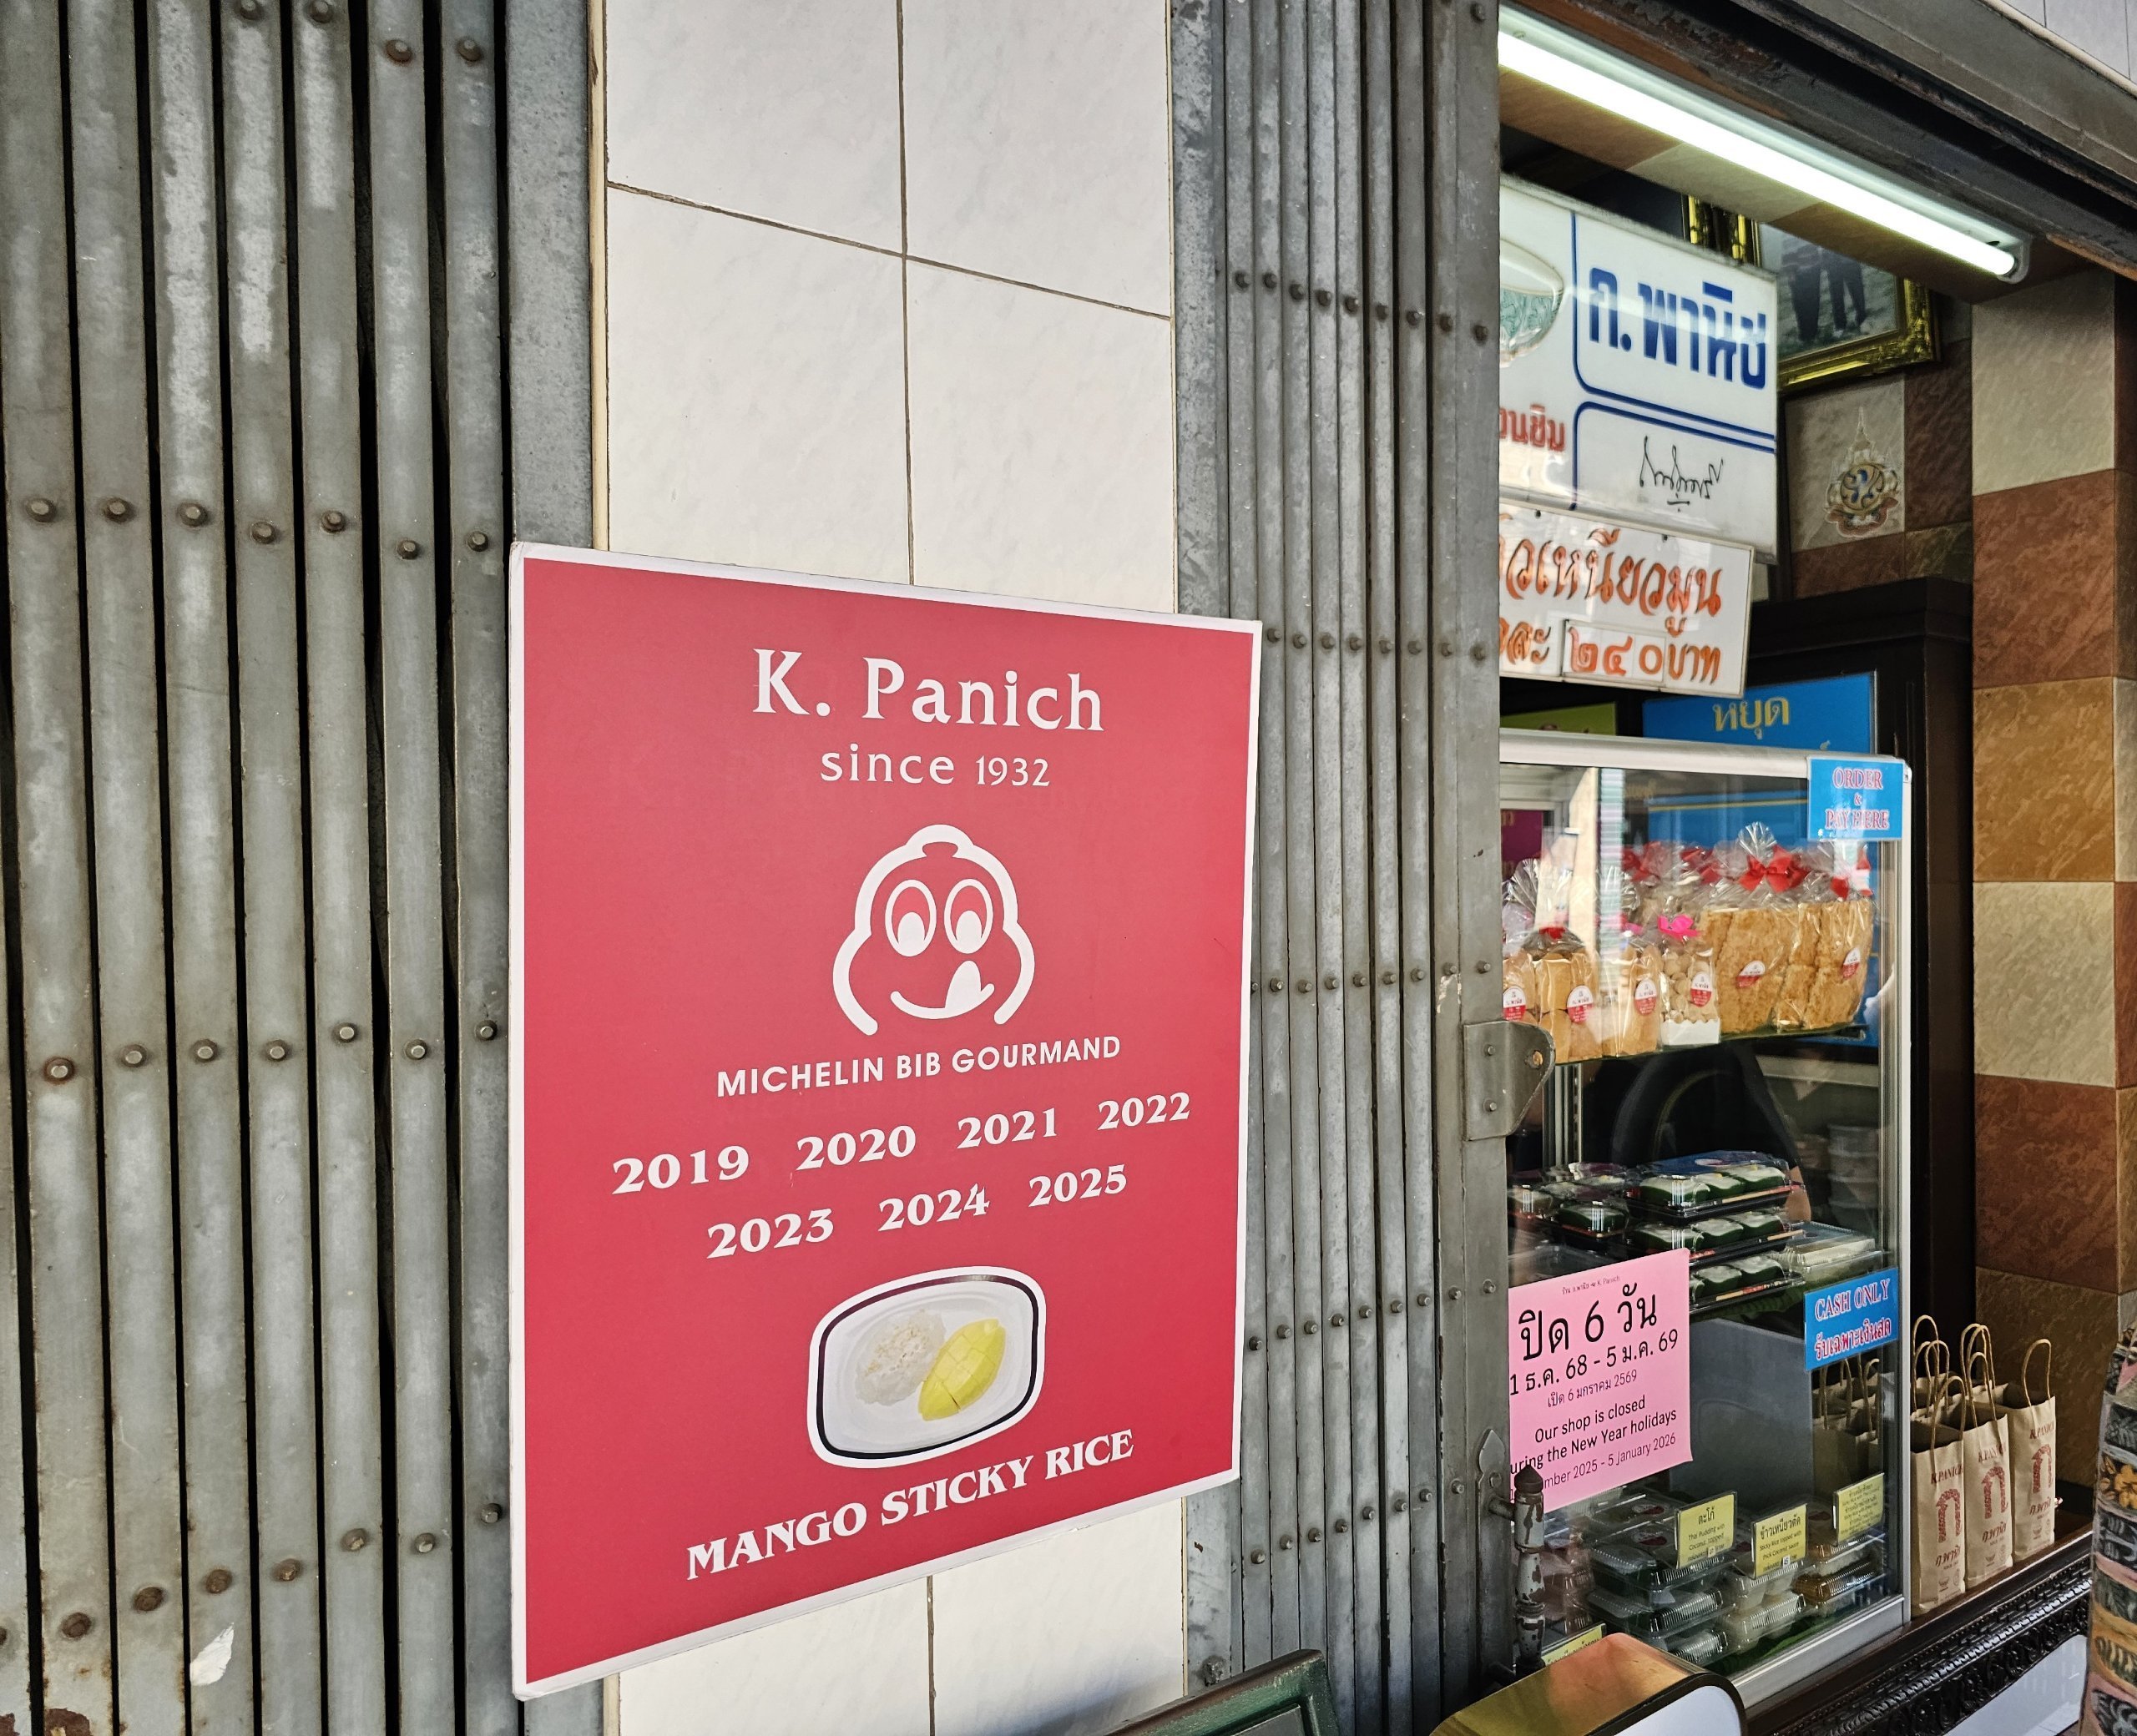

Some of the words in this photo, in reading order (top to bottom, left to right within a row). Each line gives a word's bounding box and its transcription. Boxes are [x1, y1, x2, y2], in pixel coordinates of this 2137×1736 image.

[753, 648, 831, 717] K.
[861, 657, 1104, 731] Panich
[1713, 696, 1790, 740] หยุด
[821, 743, 955, 785] since
[975, 755, 1050, 787] 1932
[1832, 767, 1883, 790] ORDER
[1825, 809, 1852, 830] PAY
[1852, 809, 1890, 830] HERE
[1854, 792, 1862, 806] &
[716, 1057, 884, 1098] MICHELIN
[896, 1052, 942, 1079] BIB
[951, 1035, 1122, 1073] GOURMAND
[612, 1145, 750, 1195] 2019
[796, 1125, 917, 1172] 2020
[956, 1108, 1058, 1150] 2021
[1097, 1092, 1191, 1130] 2022
[706, 1208, 834, 1259] 2023
[877, 1183, 991, 1232] 2024
[1028, 1164, 1129, 1208] 2025
[1518, 1309, 1569, 1361] ปิด
[1584, 1299, 1604, 1342] 6
[1617, 1282, 1658, 1333] วัน
[1815, 1289, 1852, 1321] CASH
[1854, 1278, 1891, 1309] ONLY
[1525, 1368, 1560, 1391] ธ.ค.
[1565, 1354, 1588, 1380] 68
[1606, 1345, 1617, 1367] 5
[1621, 1340, 1654, 1364] ม.ค.
[1658, 1328, 1679, 1352] 69
[1814, 1317, 1892, 1360] รับเฉพาะเงินสด
[1548, 1391, 1565, 1408] เปิด
[1568, 1389, 1574, 1401] 6
[1576, 1380, 1612, 1399] มกราคม
[1614, 1369, 1638, 1387] 2569
[1534, 1426, 1559, 1443] Our
[1561, 1416, 1591, 1435] shop
[1594, 1410, 1604, 1425] is
[1608, 1395, 1645, 1421] closed
[1509, 1453, 1543, 1475] uring
[1547, 1446, 1568, 1462] the
[1571, 1435, 1598, 1456] New
[1601, 1425, 1628, 1445] Year
[1630, 1410, 1677, 1435] holidays
[1573, 1459, 1598, 1479] 2025
[1608, 1454, 1614, 1466] 5
[1616, 1443, 1651, 1466] January
[1653, 1432, 1676, 1451] 2026
[686, 1501, 868, 1581] MANGO
[881, 1456, 1034, 1526] STICKY
[1044, 1428, 1134, 1480] RICE
[1698, 1506, 1715, 1525] ตะโก้
[1760, 1513, 1801, 1540] ข้าวเหนียวตัด
